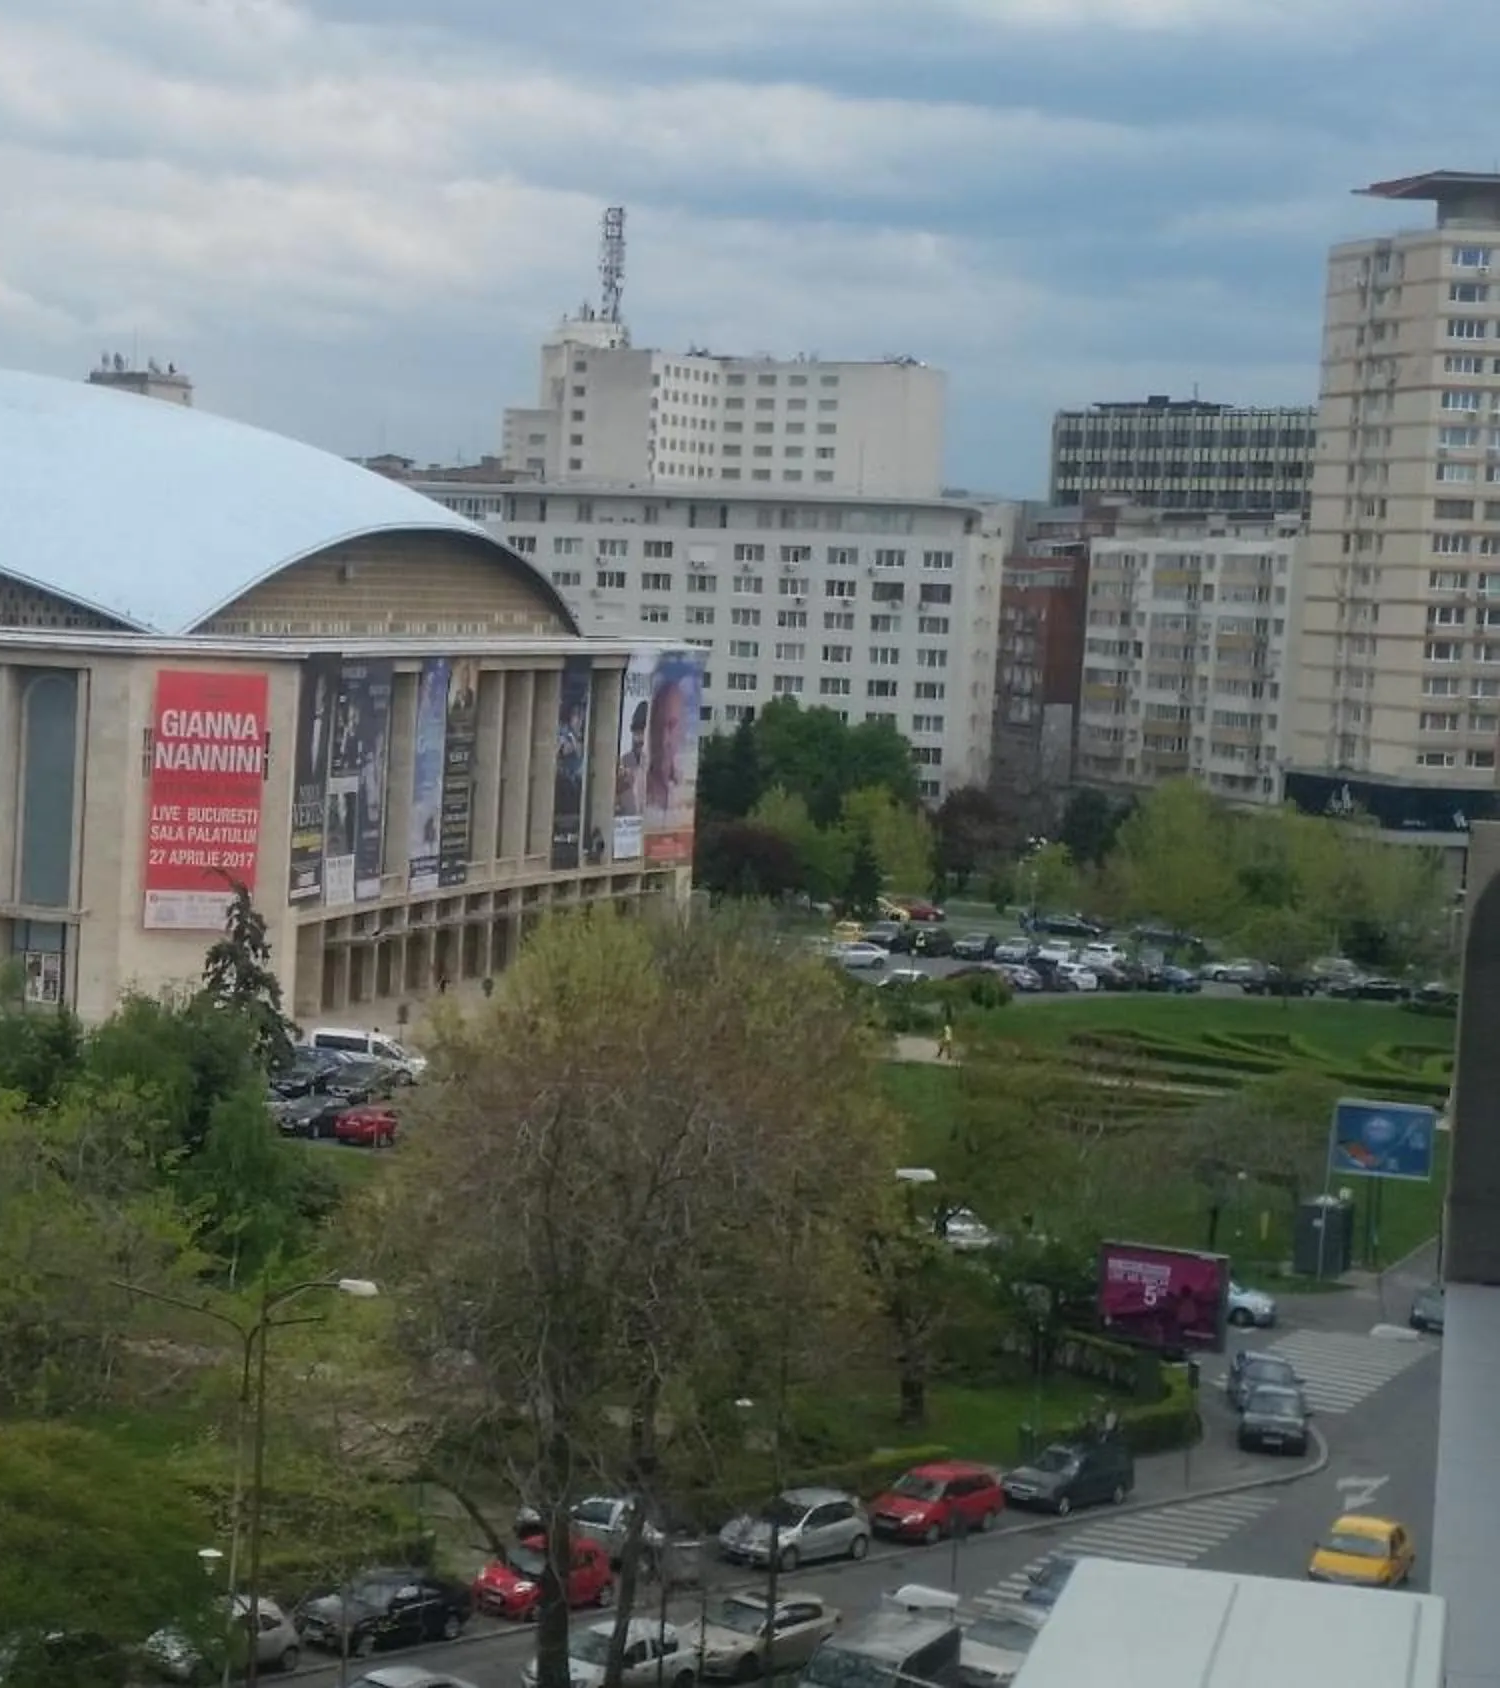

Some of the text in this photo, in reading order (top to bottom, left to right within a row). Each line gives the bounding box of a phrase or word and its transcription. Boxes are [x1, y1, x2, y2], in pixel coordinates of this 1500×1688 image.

[161, 709, 259, 741] GIANNA
[155, 741, 261, 773] NANNINI
[152, 805, 258, 824] LIVE BUCURESTI
[150, 825, 257, 844] SALA PALATULUI
[149, 849, 254, 868] 27 APRILIE 2017
